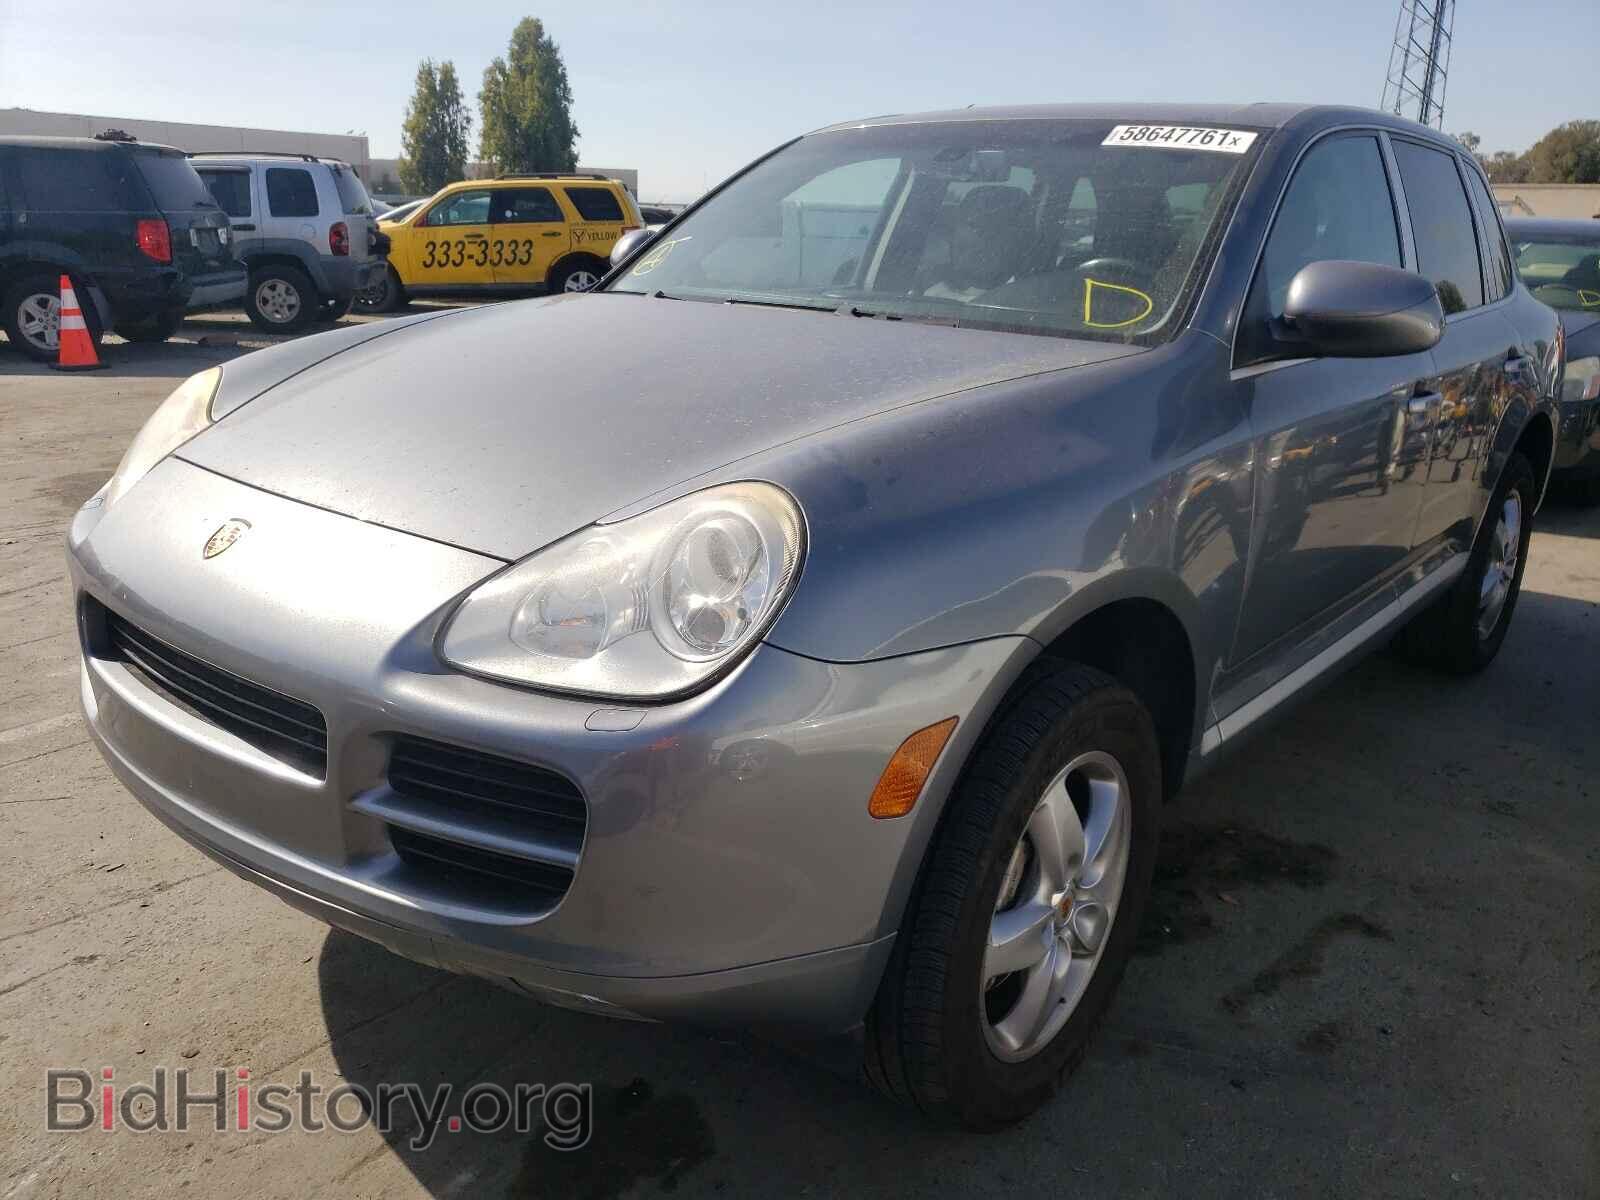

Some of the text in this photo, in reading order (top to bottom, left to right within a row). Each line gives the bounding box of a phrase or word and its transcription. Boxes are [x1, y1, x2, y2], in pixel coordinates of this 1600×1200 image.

[587, 231, 618, 241] YELLOW
[423, 240, 534, 268] 333-3333
[1083, 278, 1153, 328] D
